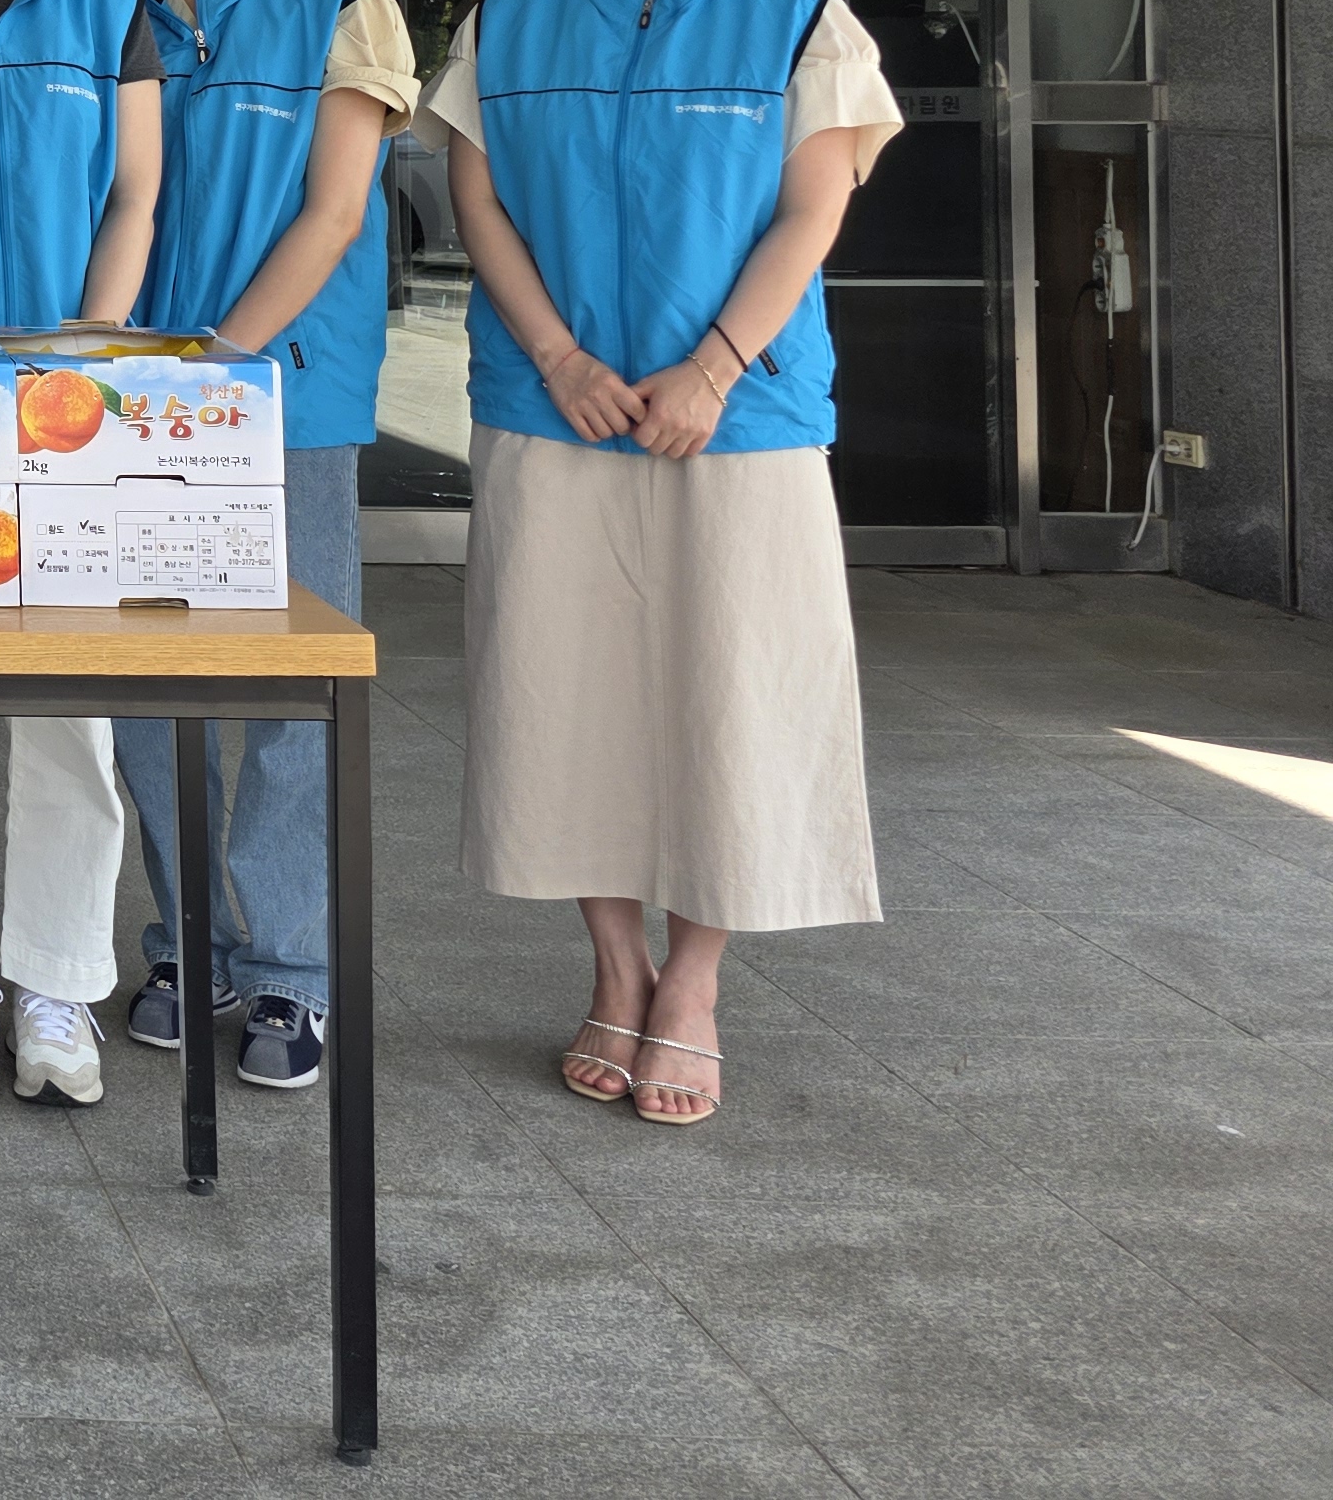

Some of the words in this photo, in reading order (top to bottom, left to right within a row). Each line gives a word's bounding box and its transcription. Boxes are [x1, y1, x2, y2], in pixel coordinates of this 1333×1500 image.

[199, 384, 245, 401] 황산벌
[118, 392, 251, 441] 복숭아
[22, 460, 49, 475] 2kg
[157, 455, 251, 468] 논산시복숭아연구회
